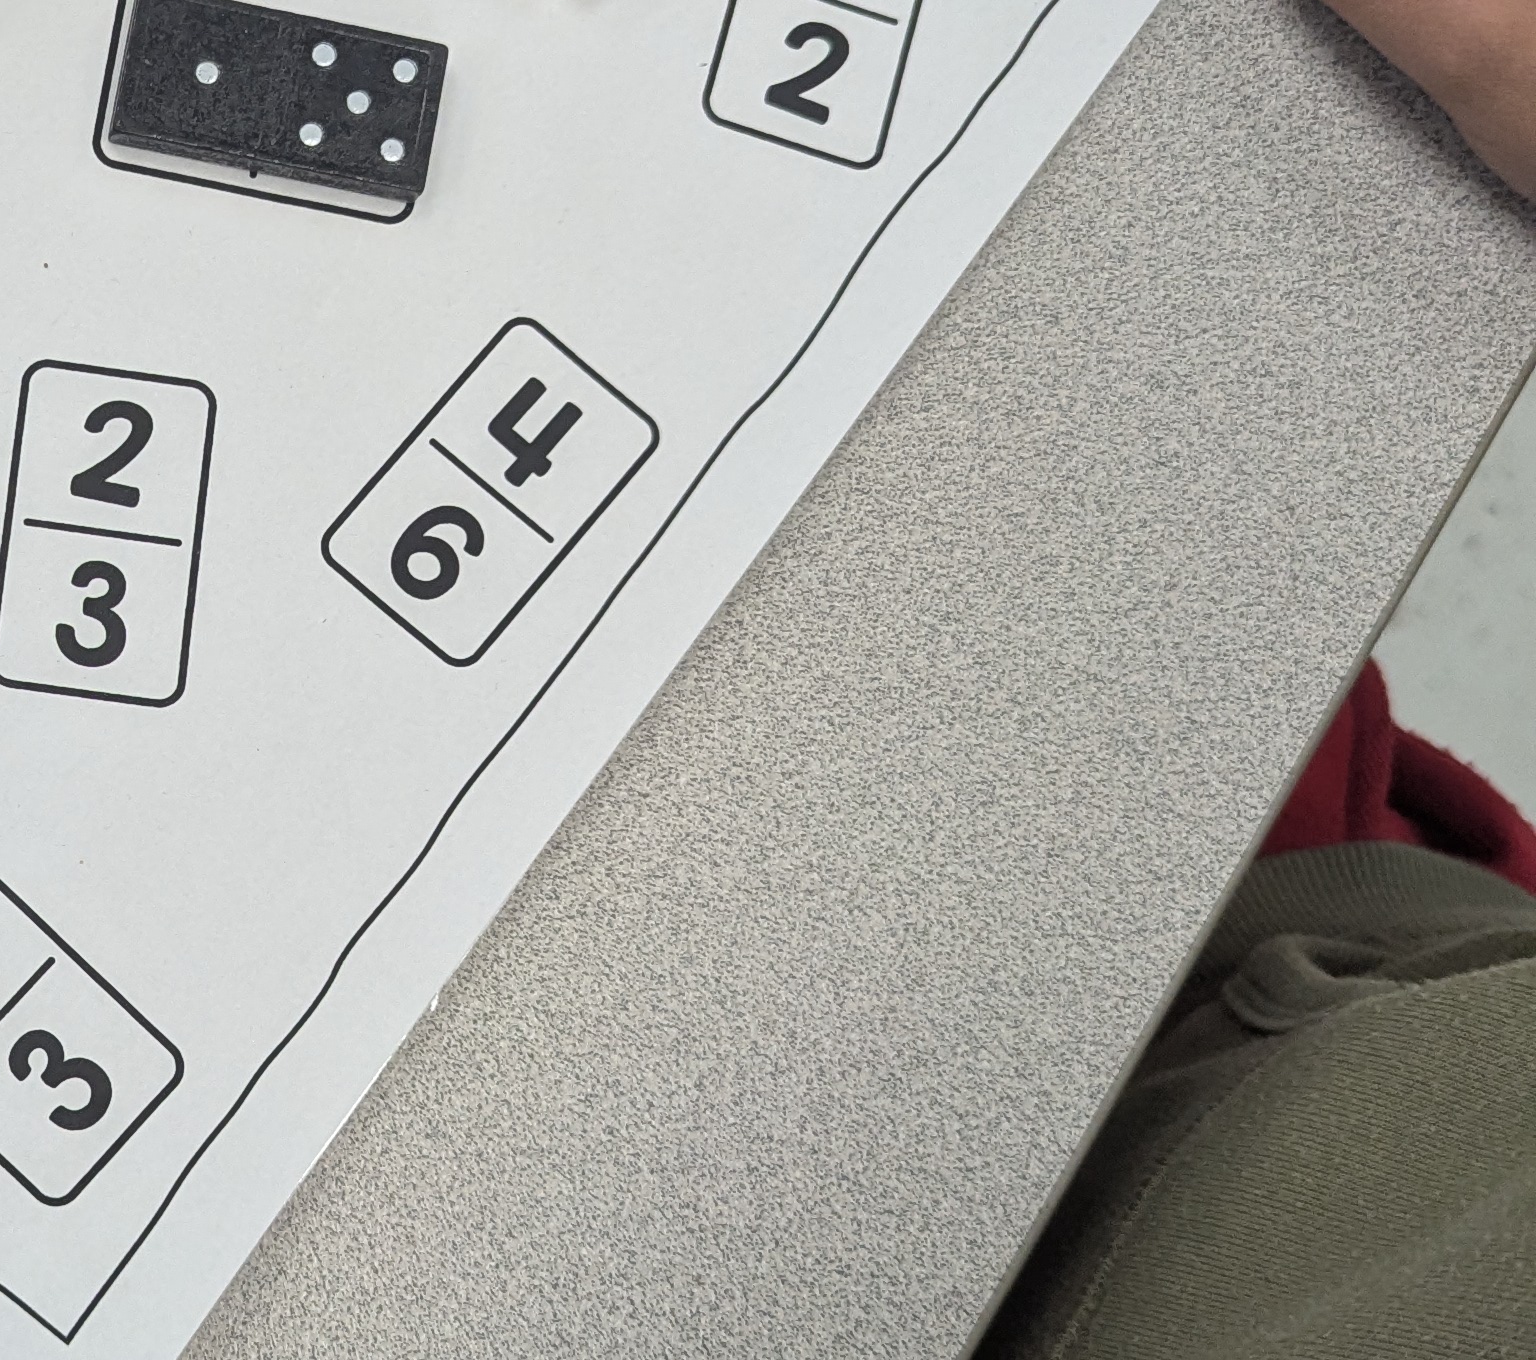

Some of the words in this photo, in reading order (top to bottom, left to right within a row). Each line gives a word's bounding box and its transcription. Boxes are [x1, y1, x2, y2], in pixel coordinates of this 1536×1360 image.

[765, 21, 850, 125] 2
[70, 400, 154, 508] 2
[487, 377, 583, 488] 4
[390, 505, 485, 601] 6
[55, 560, 127, 668] 3
[8, 1029, 113, 1131] 3
